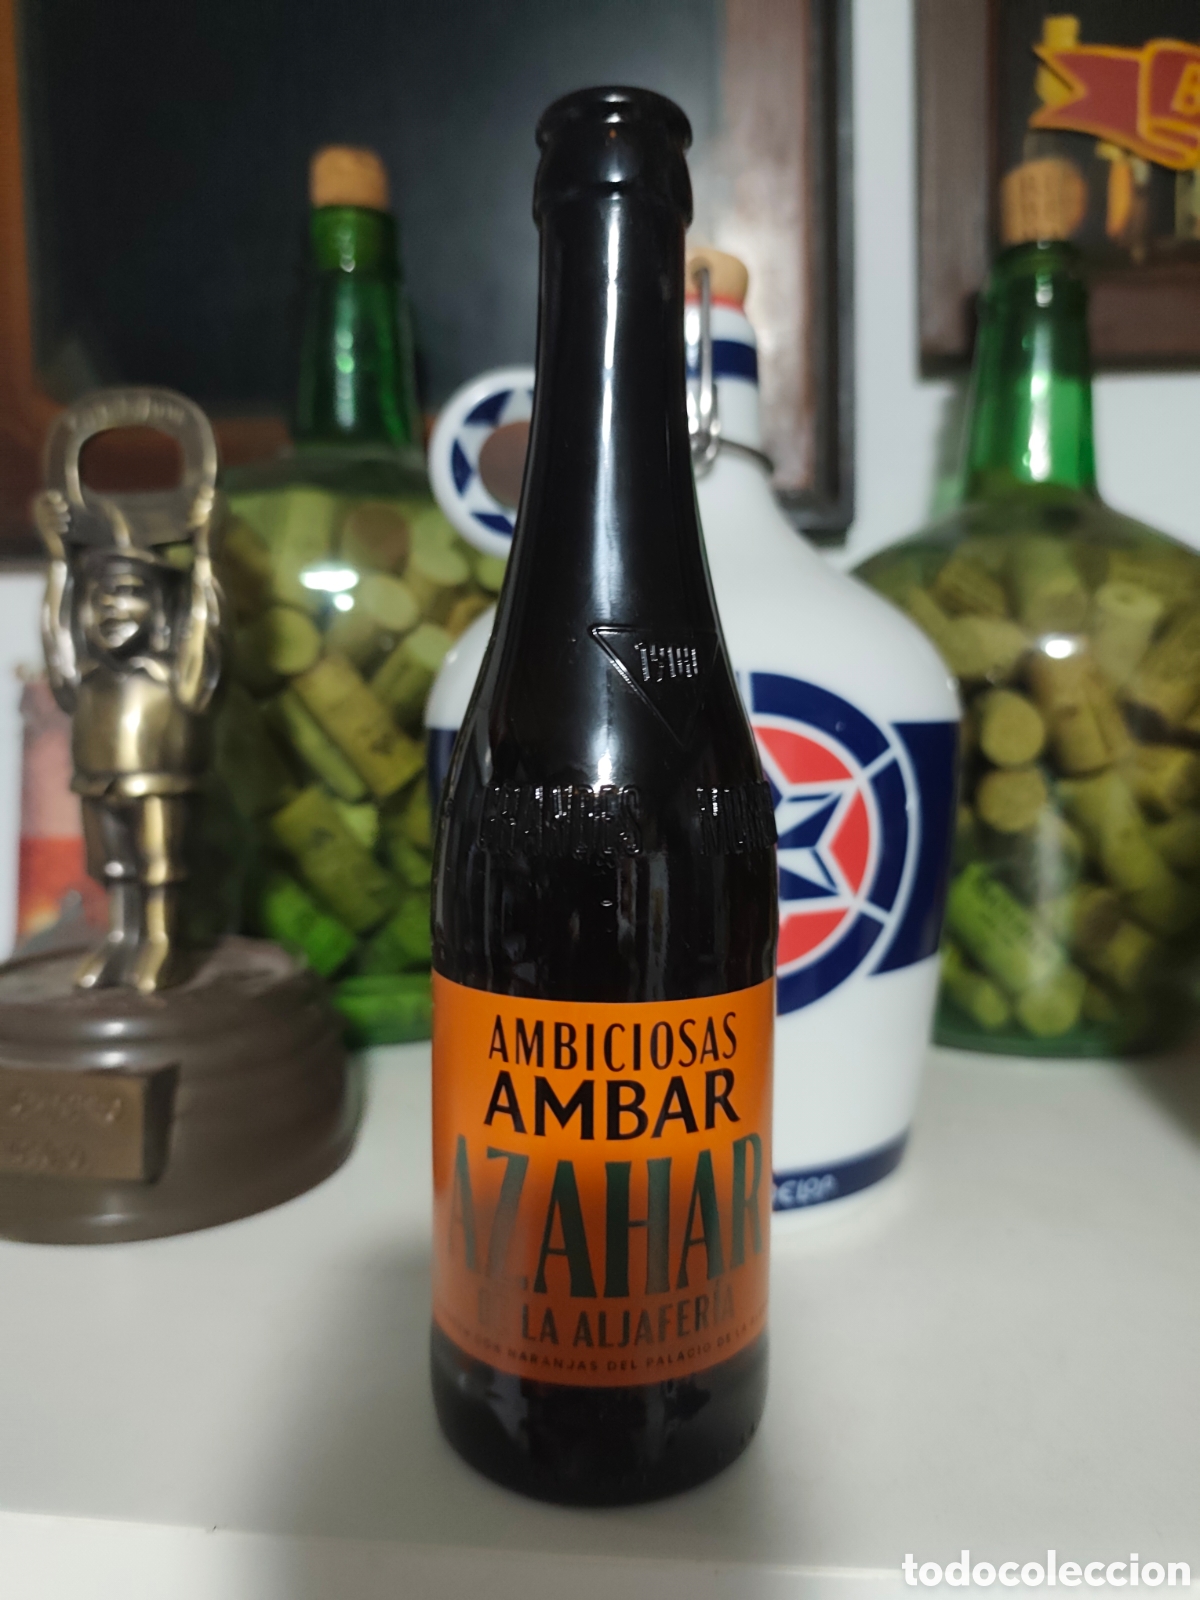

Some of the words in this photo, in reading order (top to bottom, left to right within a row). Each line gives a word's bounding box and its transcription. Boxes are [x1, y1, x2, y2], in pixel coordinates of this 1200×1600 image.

[488, 1012, 737, 1072] AMBICIOSAS
[483, 1067, 741, 1140] AMBAR
[447, 1131, 763, 1299] AZAHAR
[507, 1349, 598, 1371] NARANJAS
[606, 1359, 638, 1371] DEL
[646, 1343, 712, 1368] PALACIO
[716, 1332, 732, 1347] DE
[521, 1303, 560, 1345] LA
